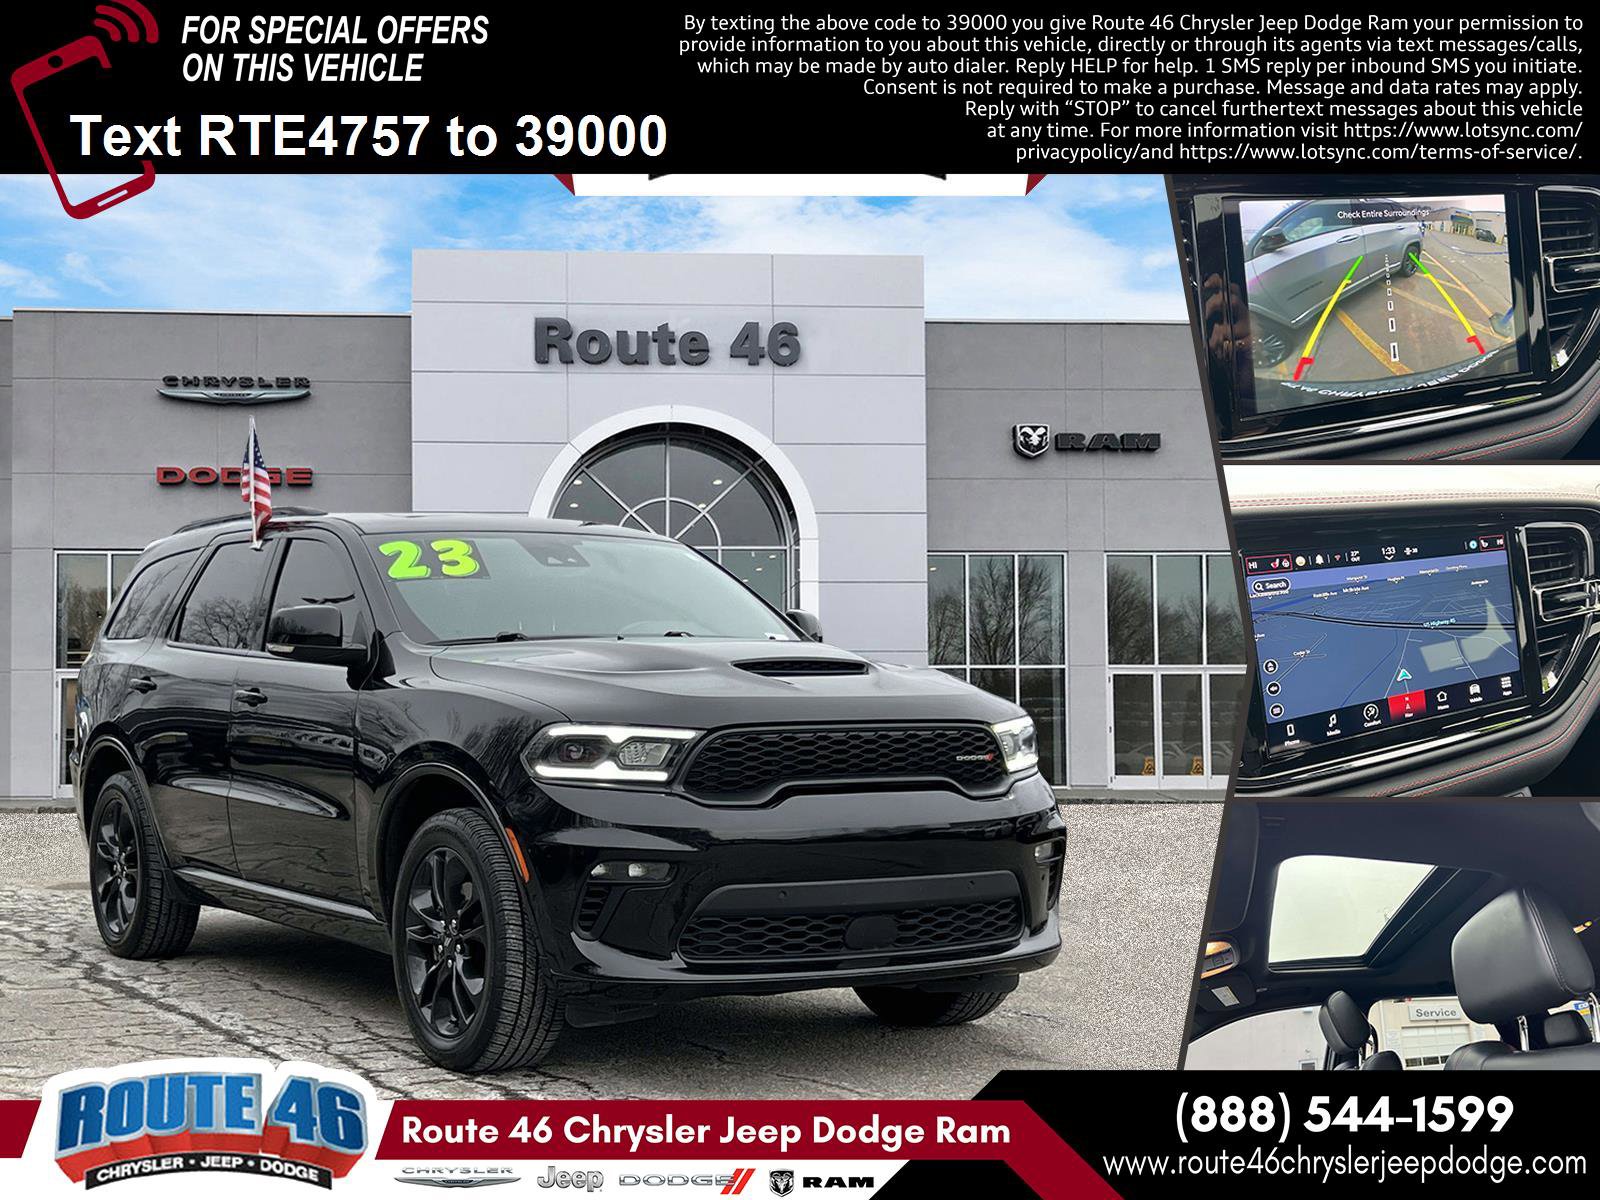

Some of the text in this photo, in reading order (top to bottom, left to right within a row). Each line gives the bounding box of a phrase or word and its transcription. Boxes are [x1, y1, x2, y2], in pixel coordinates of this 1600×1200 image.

[1337, 209, 1430, 219] Check Entire Surroundings
[534, 317, 801, 367] Route 46
[162, 375, 311, 388] CHRYSLER
[1055, 433, 1161, 452] RAM
[1381, 546, 1396, 555] 1:33
[378, 539, 481, 581] 23
[1265, 581, 1287, 590] Search
[1363, 719, 1382, 728] Comfort
[1326, 729, 1341, 737] Media
[1415, 1008, 1457, 1018] Service
